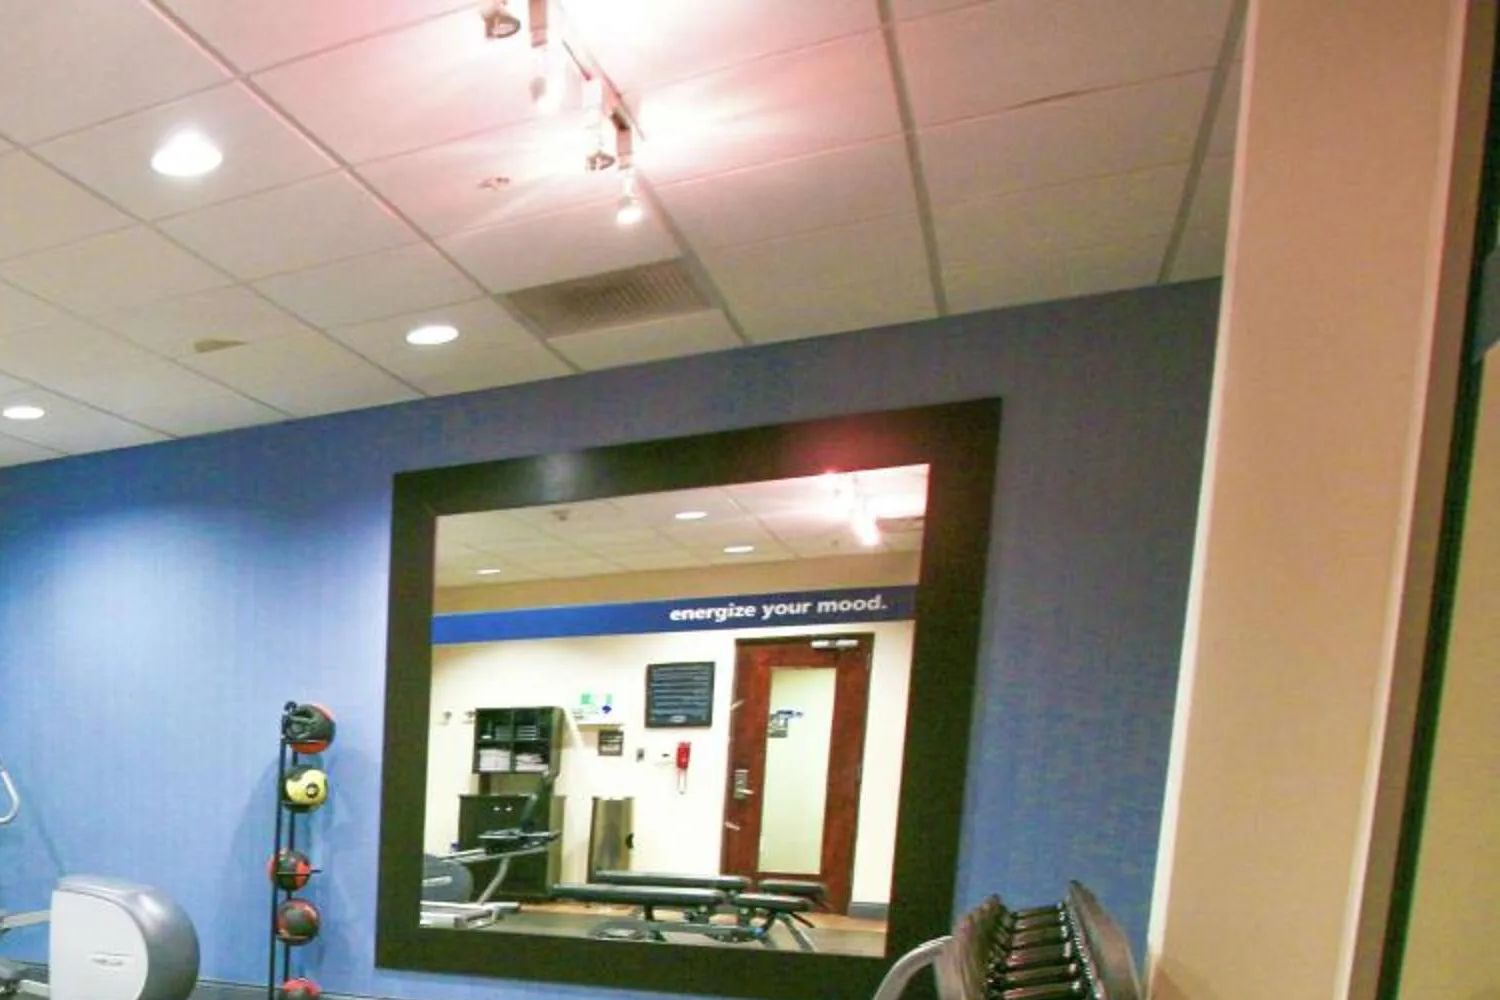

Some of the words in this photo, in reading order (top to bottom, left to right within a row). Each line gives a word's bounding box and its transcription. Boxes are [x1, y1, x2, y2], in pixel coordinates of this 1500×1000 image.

[669, 603, 756, 622] energize
[761, 601, 811, 619] your
[817, 595, 887, 613] mood.
